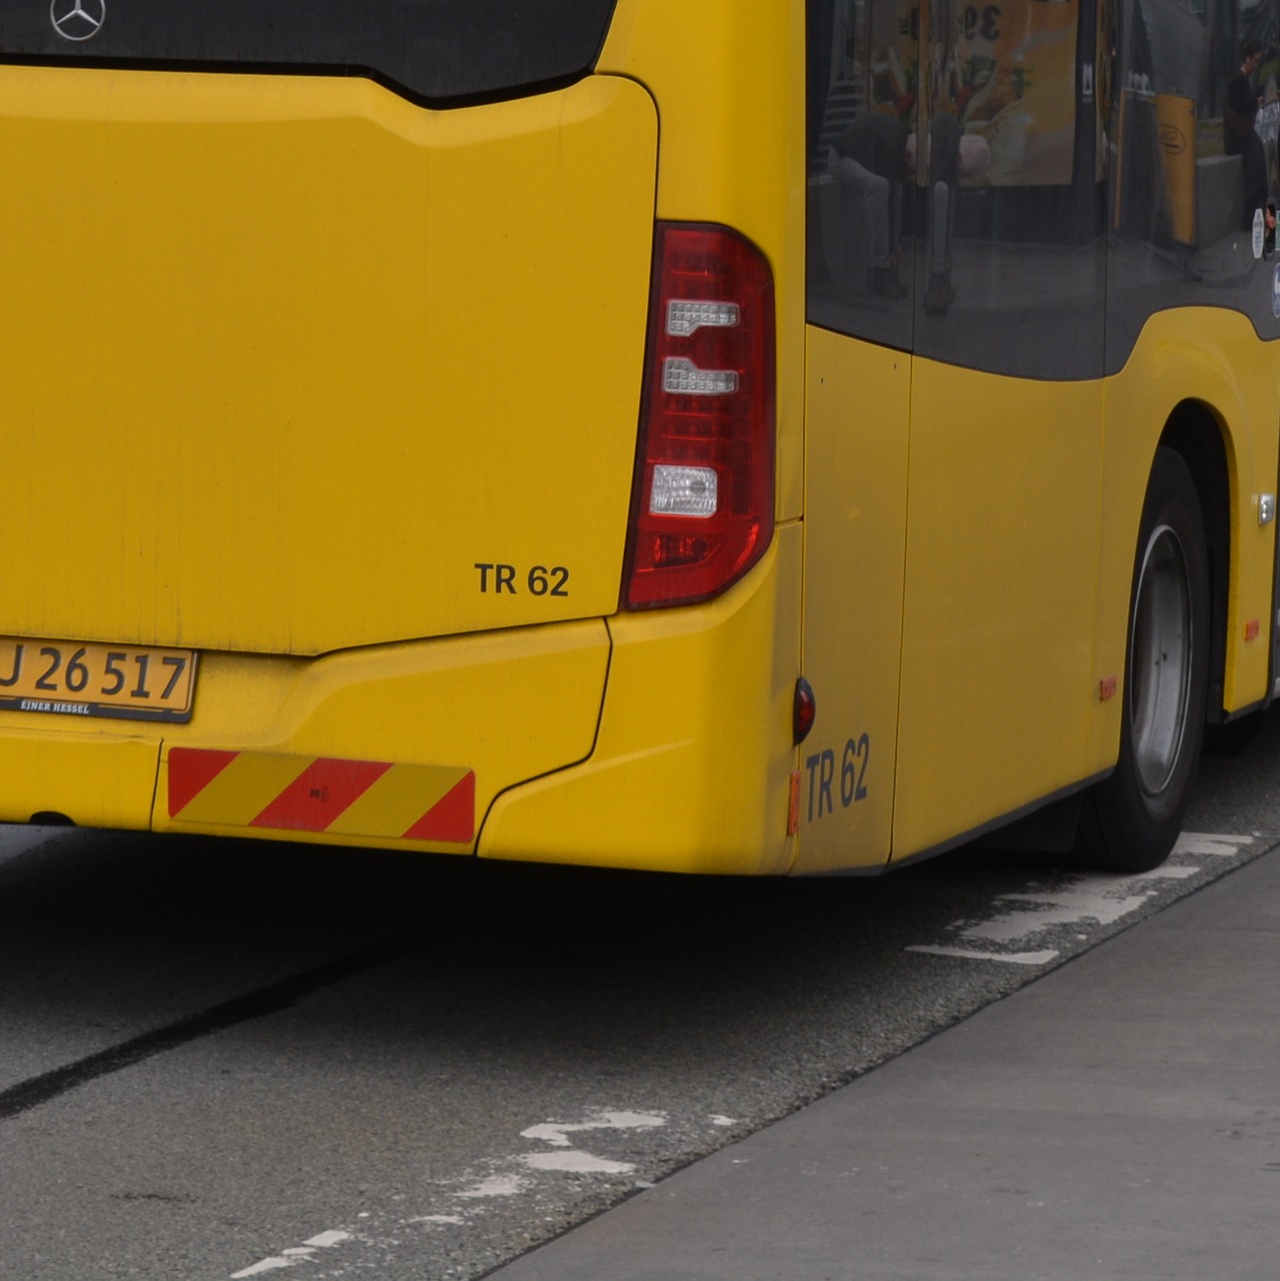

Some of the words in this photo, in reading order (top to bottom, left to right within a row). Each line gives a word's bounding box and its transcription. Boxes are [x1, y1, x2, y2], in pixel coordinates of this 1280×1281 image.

[474, 562, 517, 595] TR
[527, 565, 569, 597] 62
[35, 646, 90, 693] 26
[101, 652, 187, 700] 517
[20, 700, 51, 712] EJNER
[53, 702, 90, 715] HESSEL
[806, 748, 835, 823] TR
[840, 732, 870, 808] 62
